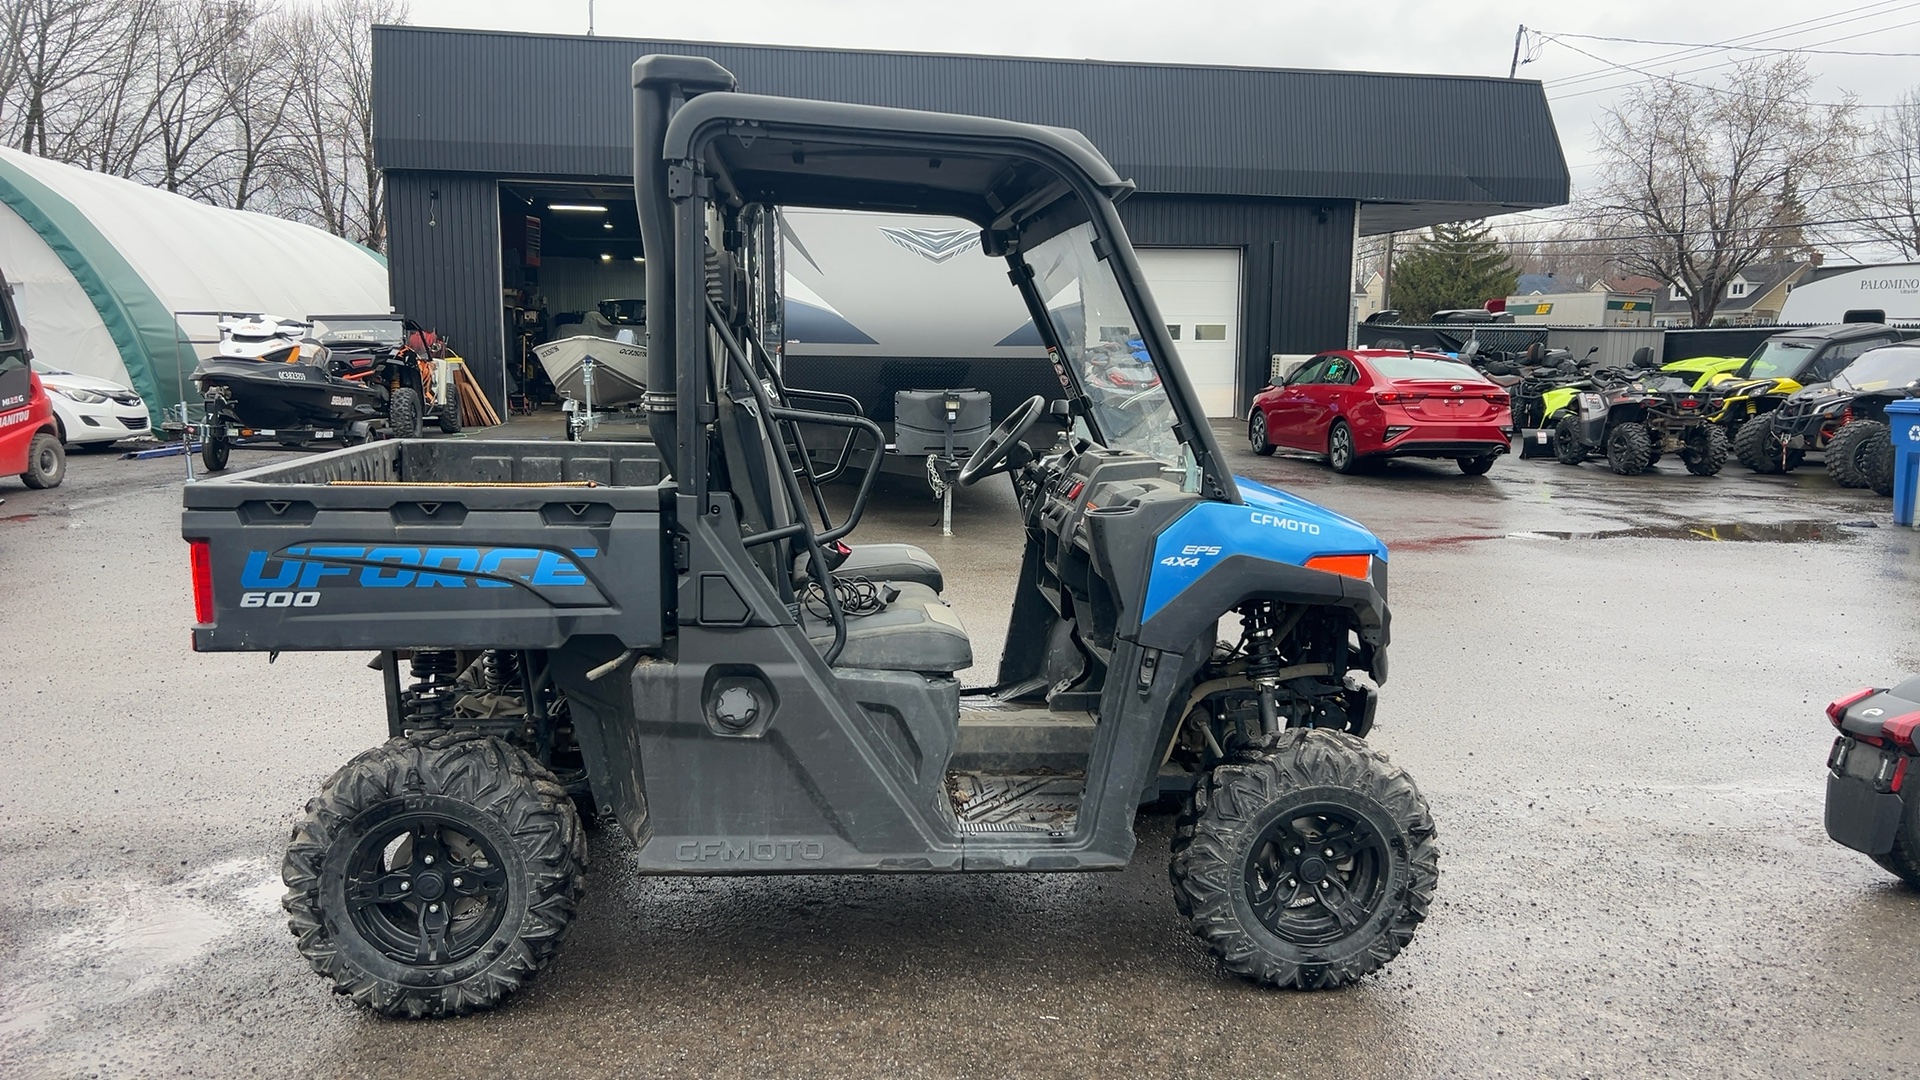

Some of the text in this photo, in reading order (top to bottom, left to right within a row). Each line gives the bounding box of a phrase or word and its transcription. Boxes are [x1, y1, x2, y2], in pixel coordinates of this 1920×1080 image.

[1860, 279, 1919, 290] PALOMINO
[0, 409, 30, 429] ANITOU
[1250, 511, 1321, 536] CFMOTO
[1181, 545, 1222, 556] EPS
[240, 546, 598, 589] UFORCE
[240, 591, 321, 608] 600
[675, 840, 825, 862] CFMOTO
